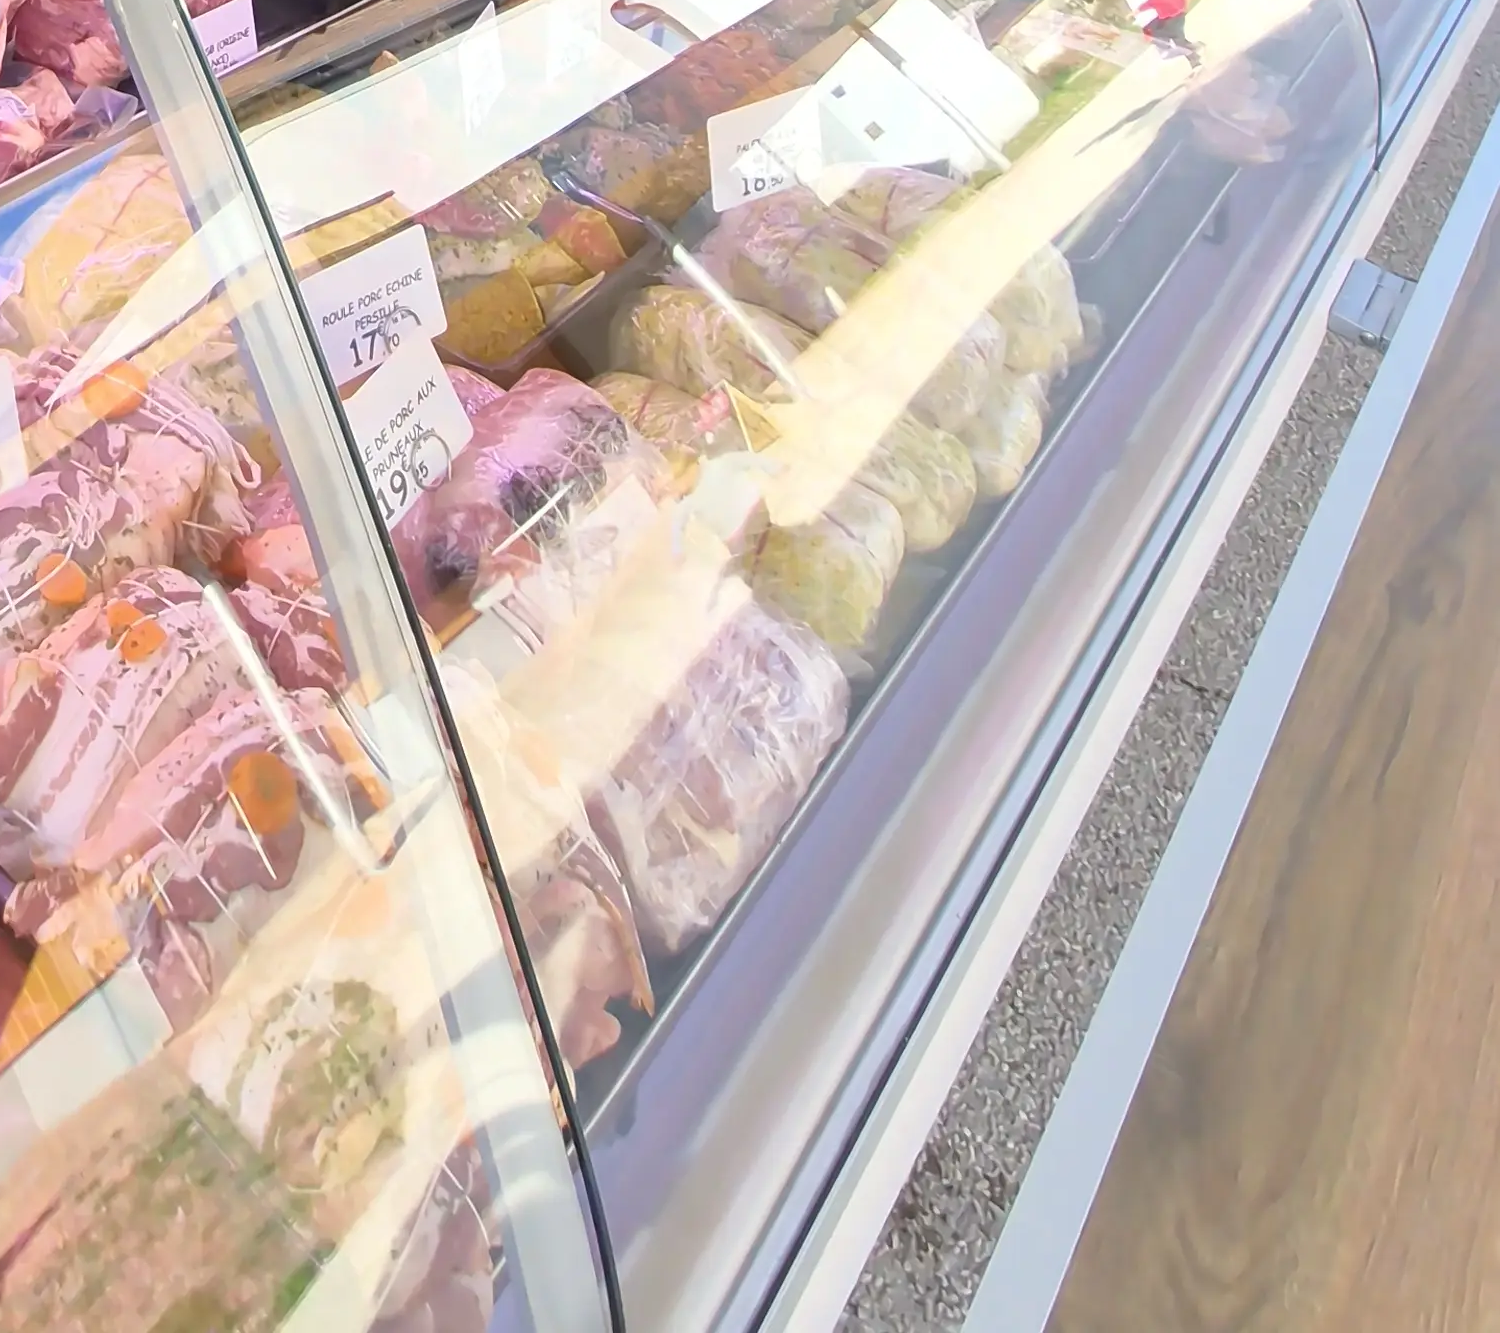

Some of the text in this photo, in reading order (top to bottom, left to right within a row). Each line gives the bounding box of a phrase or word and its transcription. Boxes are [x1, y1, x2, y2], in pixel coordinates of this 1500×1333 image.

[321, 268, 423, 329] ROULE PORC ECHINE
[354, 299, 401, 333] PERSILLE
[374, 429, 389, 452] DE
[389, 402, 415, 433] PORC
[416, 375, 438, 404] AUX
[372, 420, 426, 483] PRUNEAUX
